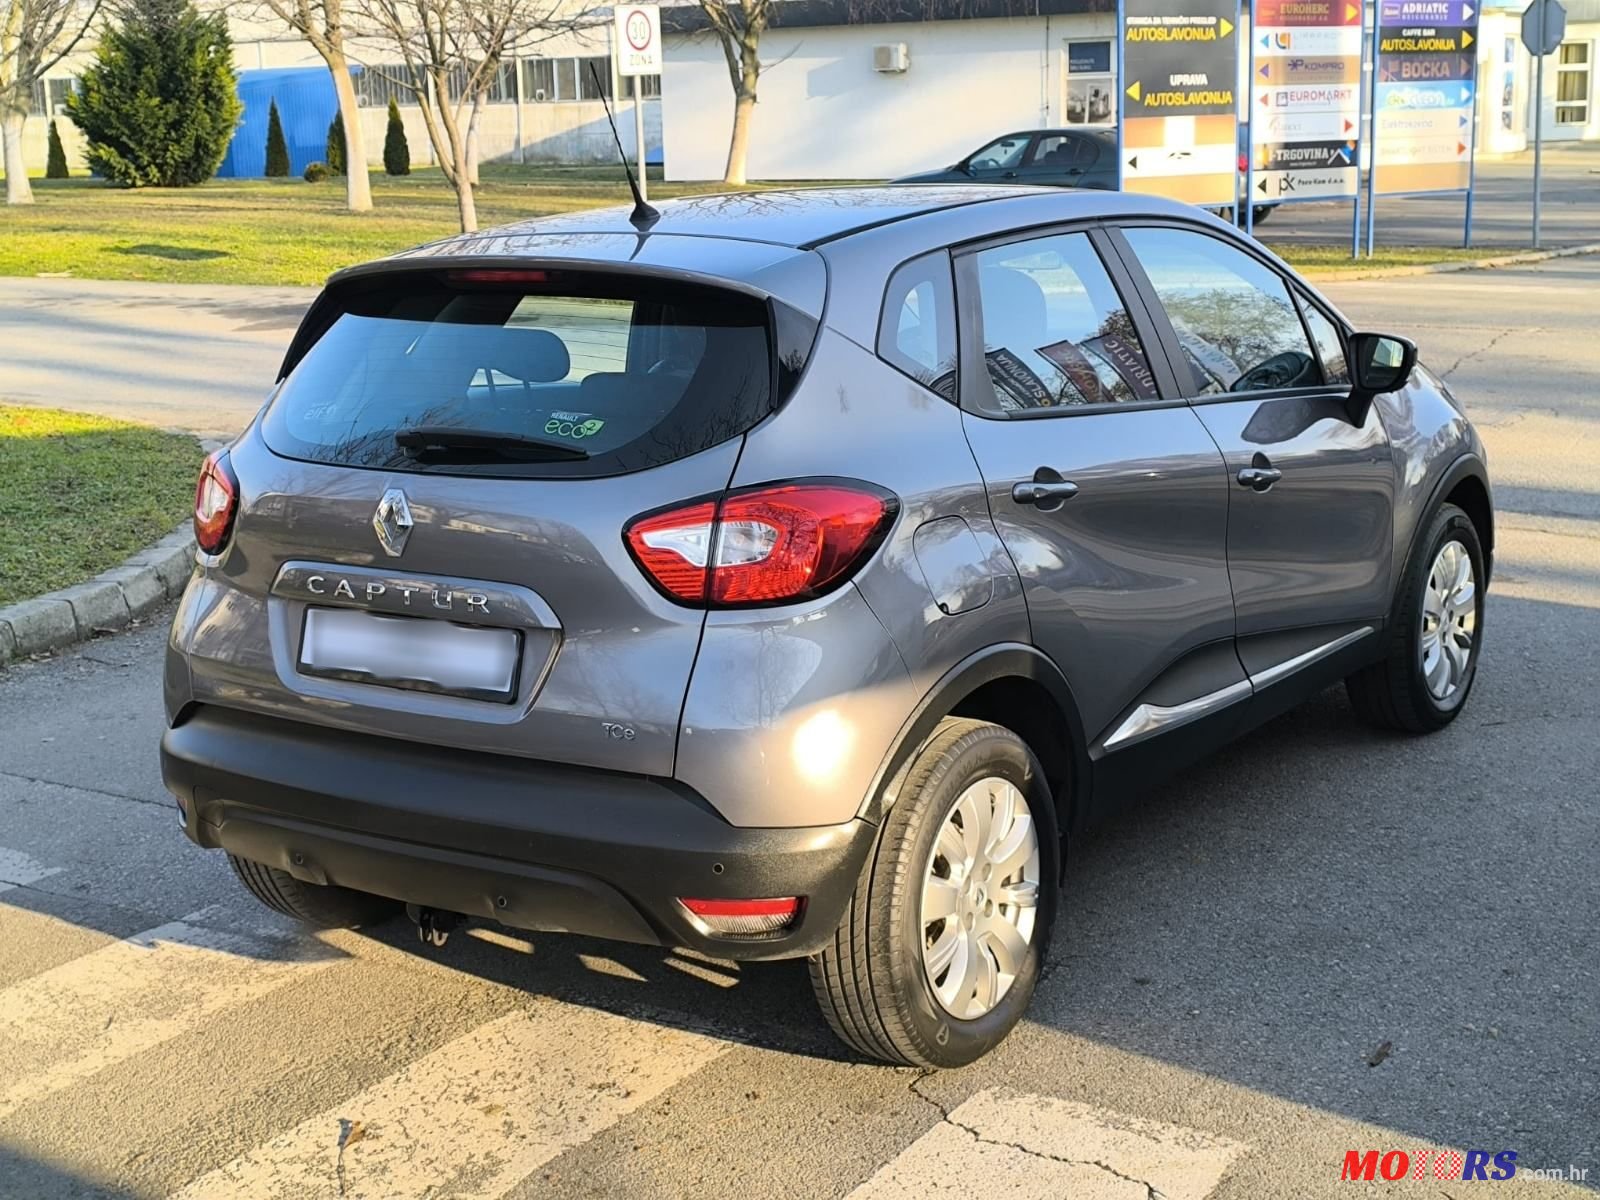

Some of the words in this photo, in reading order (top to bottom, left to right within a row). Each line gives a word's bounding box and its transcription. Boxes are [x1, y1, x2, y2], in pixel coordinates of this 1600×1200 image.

[1280, 3, 1329, 14] EUROHERC
[1402, 3, 1449, 14] ADRIATIC
[1126, 27, 1217, 41] AUTOSLAVONIJA
[1380, 38, 1456, 52] AUTOSLAVONIJA
[1401, 61, 1451, 79] BOCKA
[1169, 73, 1209, 87] UPRAVA
[1144, 91, 1233, 107] AUTOSLAVONIJA
[1290, 90, 1353, 103] EUROMARKT
[1105, 340, 1157, 395] DRIATIC
[550, 411, 579, 422] RENAULT
[306, 575, 490, 614] CAPTUR
[601, 722, 635, 740] TCe
